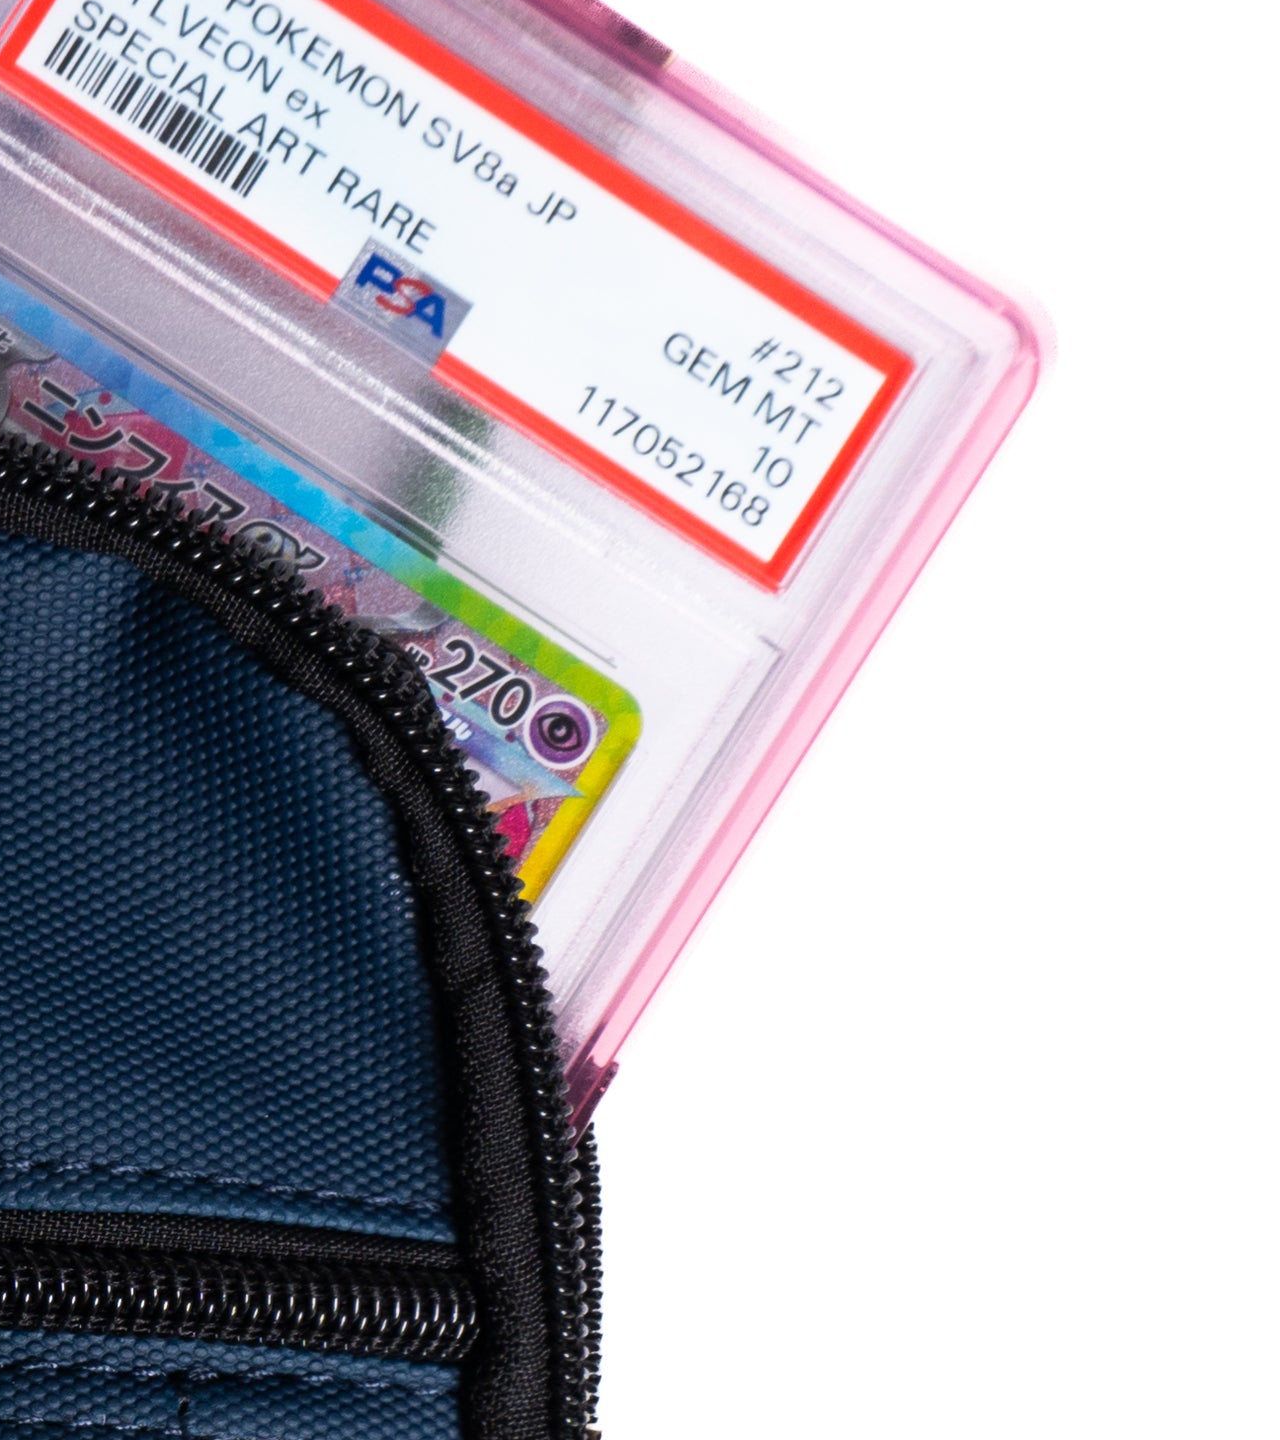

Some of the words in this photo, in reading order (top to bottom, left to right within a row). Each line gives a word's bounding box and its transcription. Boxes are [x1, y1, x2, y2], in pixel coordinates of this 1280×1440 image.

[285, 85, 333, 129] ex
[236, 110, 329, 178] ART
[326, 165, 438, 256] RARE
[422, 115, 520, 199] SV8a
[526, 190, 579, 228] JP
[354, 253, 448, 339] PSA
[662, 331, 753, 406] GEM
[753, 389, 824, 446] MT
[749, 335, 845, 412] #212
[576, 383, 772, 529] 117052168
[750, 445, 795, 490] 10
[425, 636, 535, 730] 270
